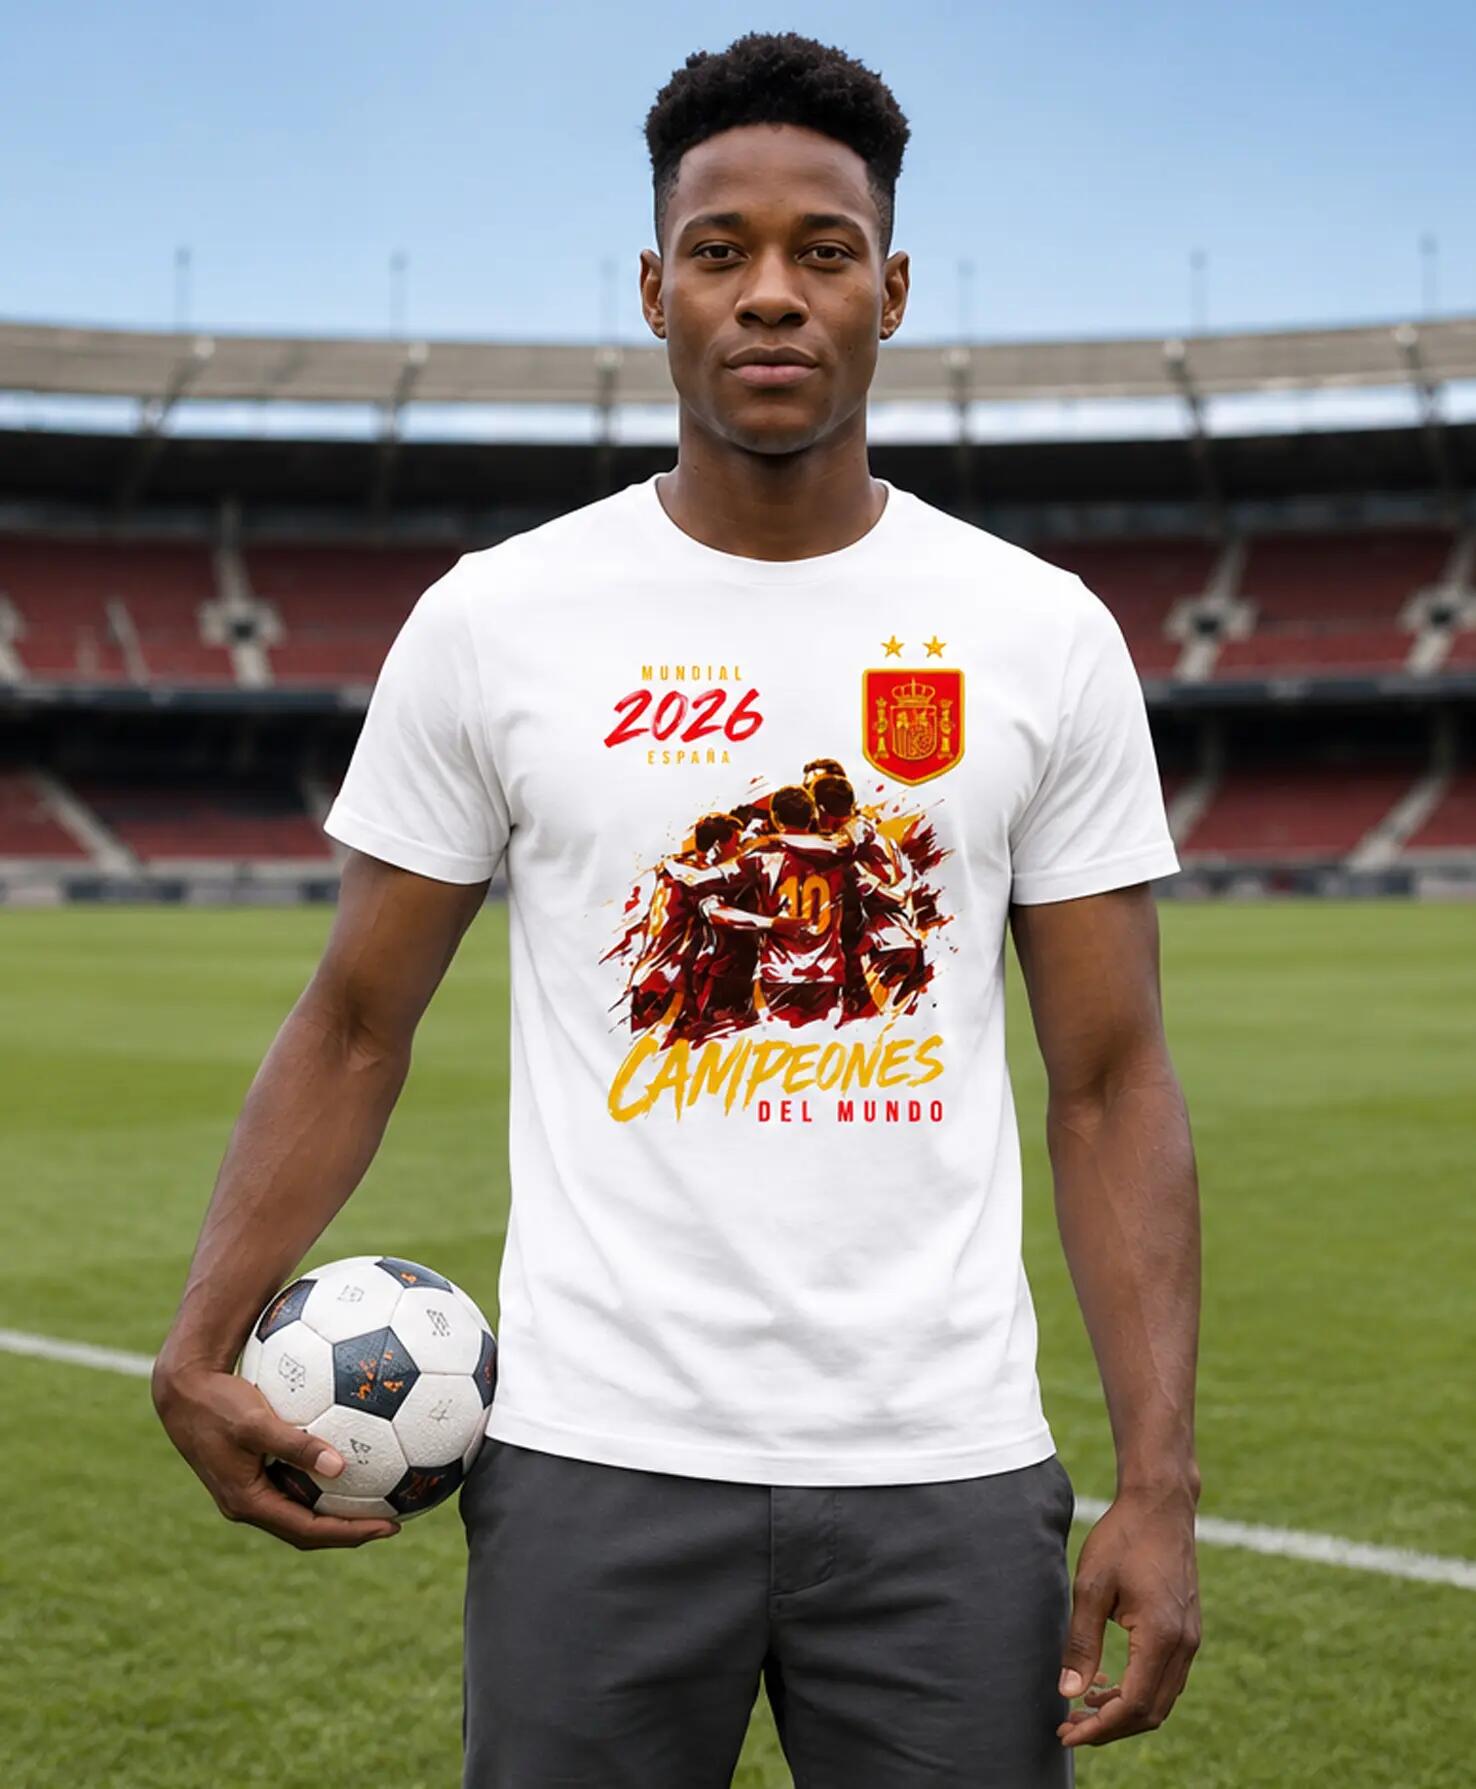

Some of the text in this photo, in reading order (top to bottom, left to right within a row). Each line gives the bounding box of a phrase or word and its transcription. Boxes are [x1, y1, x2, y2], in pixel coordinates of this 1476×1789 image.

[641, 665, 742, 681] MUNDIAL
[604, 688, 764, 748] 2026
[647, 749, 730, 765] ESPAÑA
[778, 875, 831, 936] 10
[607, 1033, 944, 1124] CAMPEONES
[758, 1099, 944, 1123] DEL MUNDO
